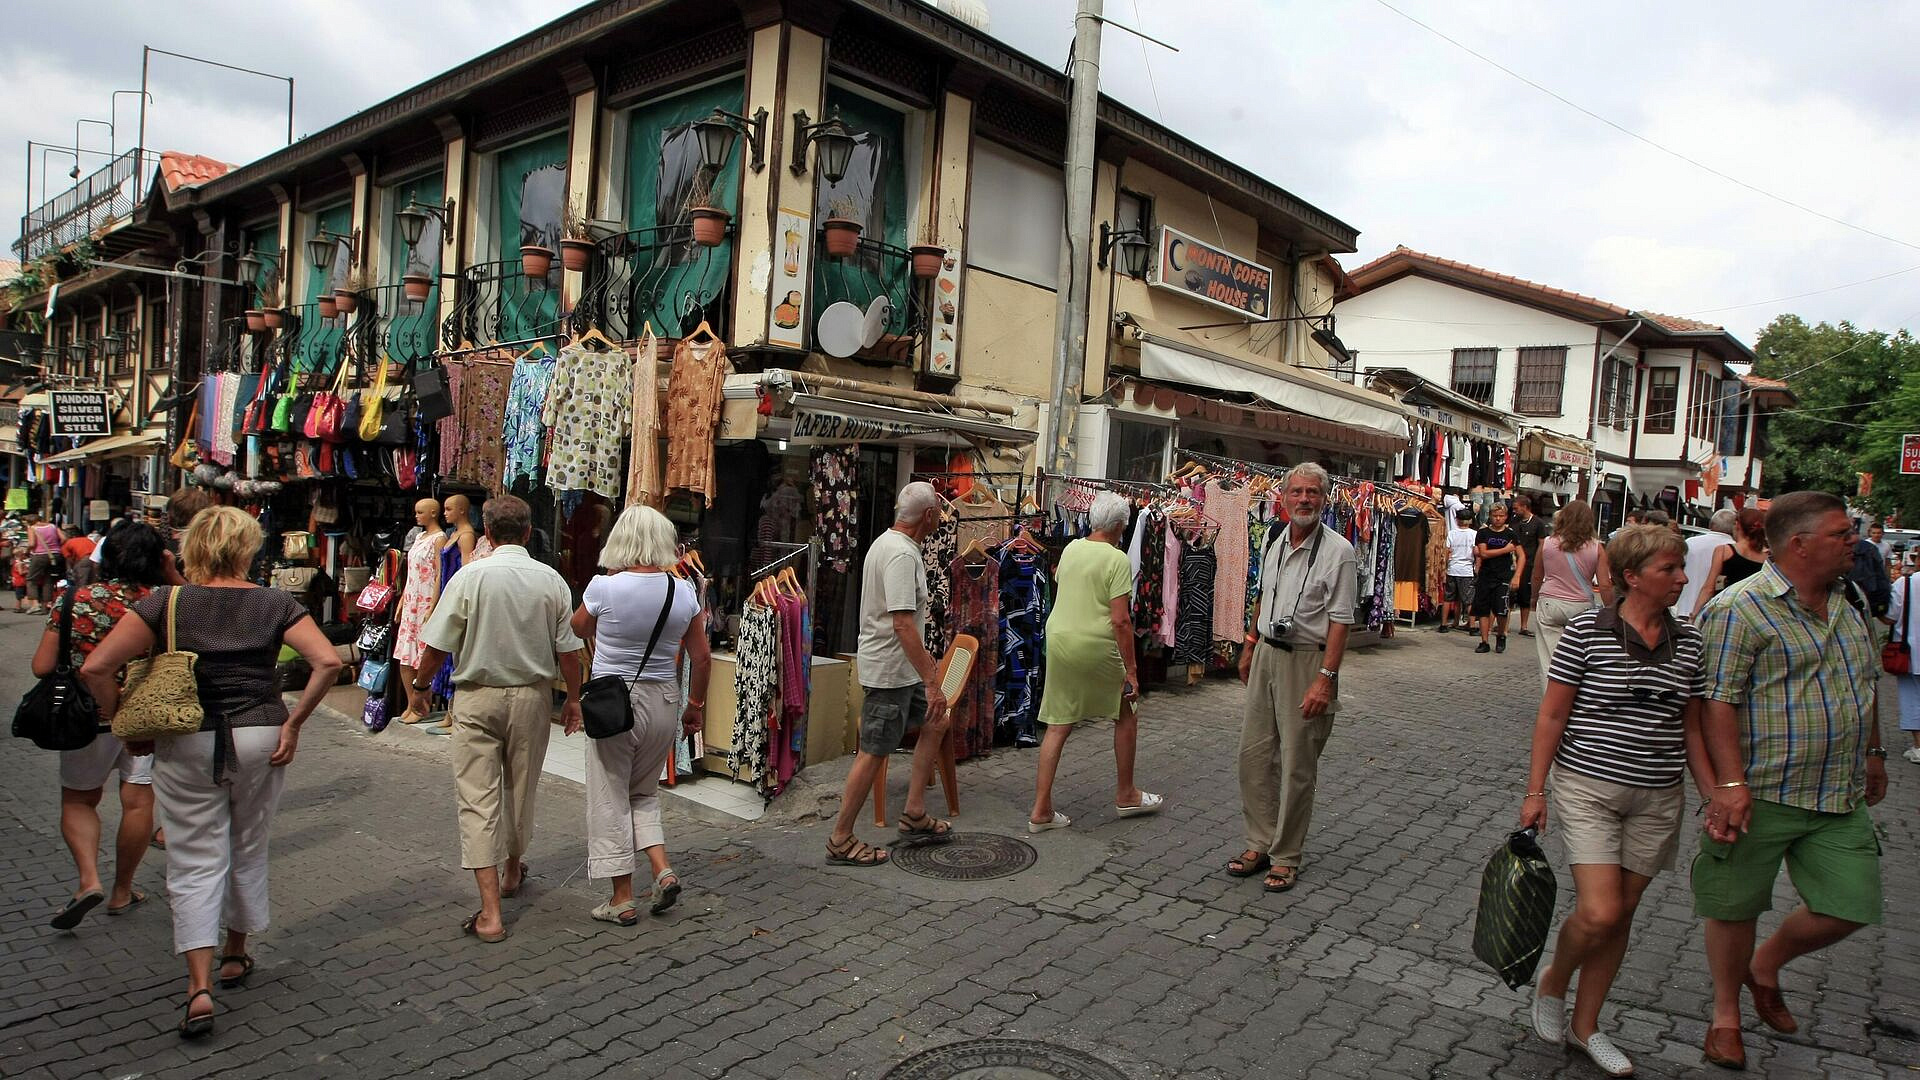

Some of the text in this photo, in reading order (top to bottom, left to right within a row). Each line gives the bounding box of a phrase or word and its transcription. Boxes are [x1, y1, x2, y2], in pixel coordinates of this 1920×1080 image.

[1186, 244, 1269, 290] MONTH COFFE
[1206, 279, 1249, 309] HOUSE
[55, 394, 102, 404] PANDORA
[57, 415, 104, 423] WATCH
[63, 423, 100, 432] STELL
[794, 412, 842, 437] ZAFER
